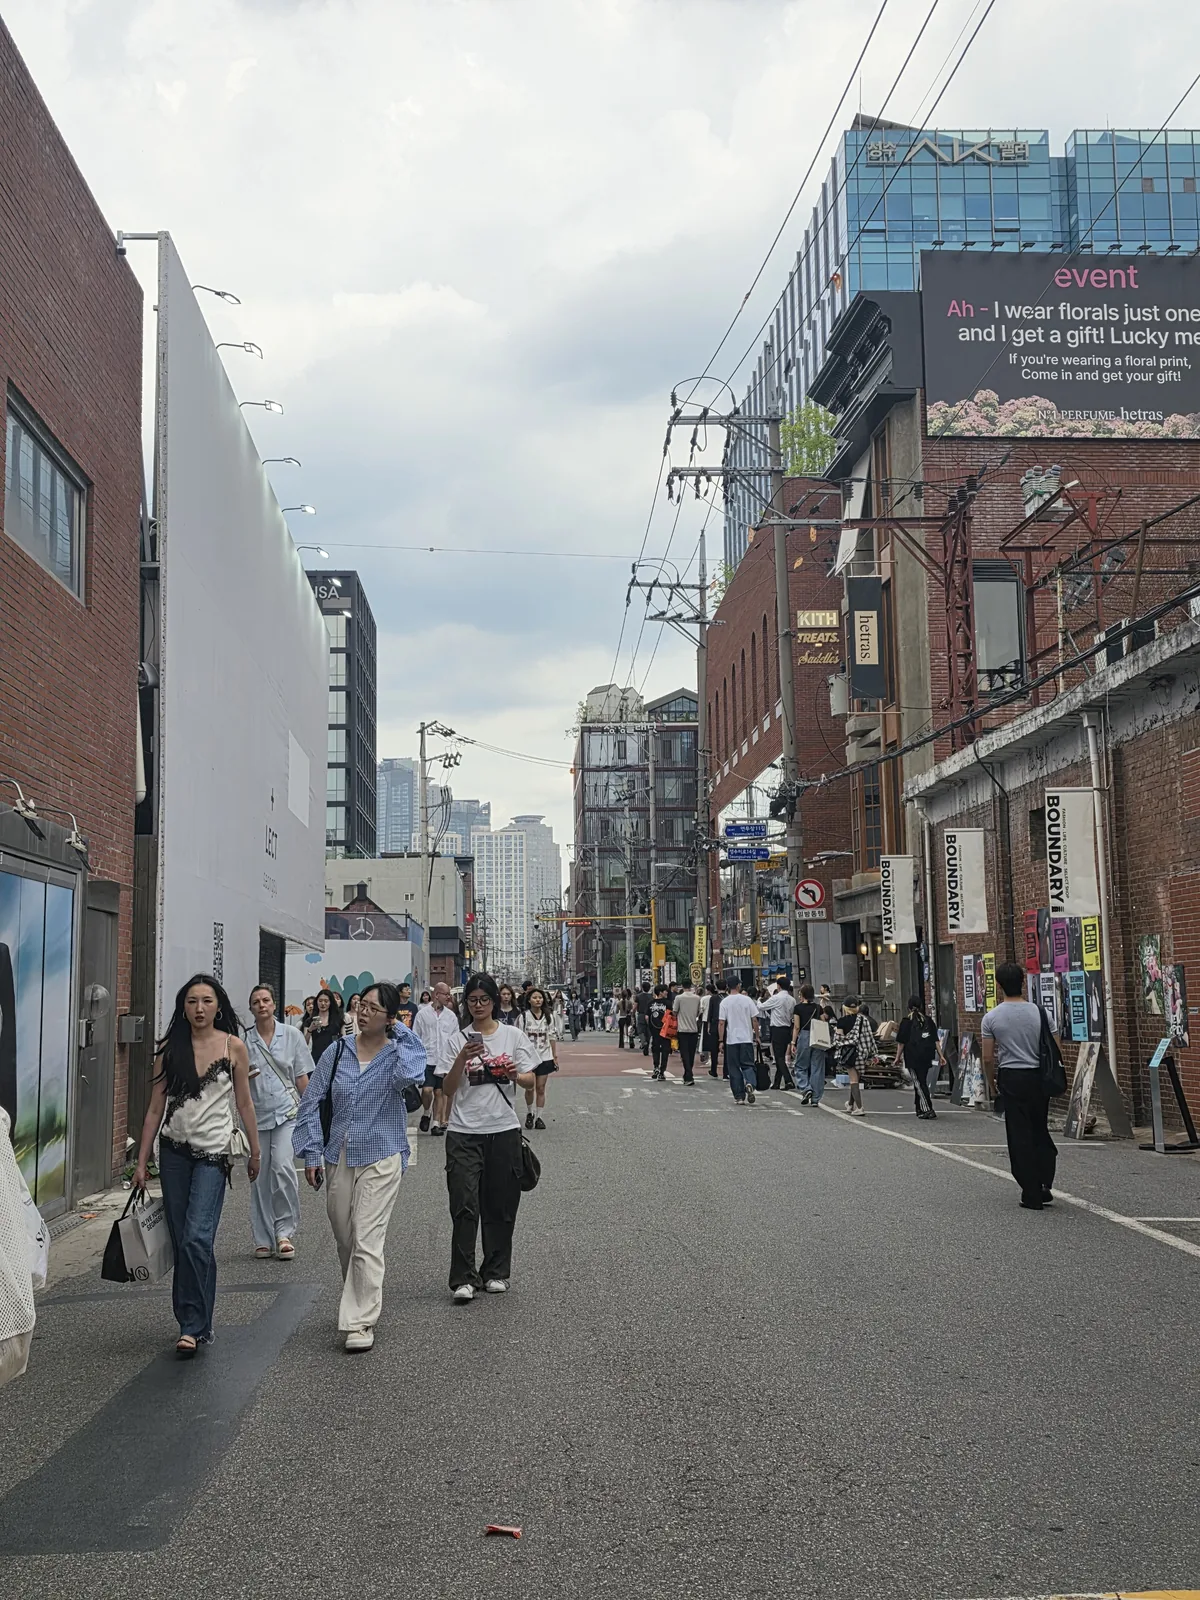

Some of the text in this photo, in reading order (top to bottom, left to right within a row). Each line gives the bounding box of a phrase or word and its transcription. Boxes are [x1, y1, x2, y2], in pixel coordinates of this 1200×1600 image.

[1054, 265, 1138, 288] event
[947, 300, 974, 318] Ah
[994, 302, 1000, 318] I
[1004, 304, 1054, 320] wear
[1059, 302, 1120, 321] florals
[1124, 304, 1160, 324] just
[958, 324, 996, 342] and
[1002, 325, 1006, 342] I
[1012, 327, 1044, 346] get
[1050, 330, 1061, 344] a
[1066, 326, 1104, 348] gift!
[1110, 328, 1169, 348] Lucky
[1009, 353, 1192, 369] If you're wearing a floral print,
[1022, 369, 1182, 384] Come in and get your gift!
[1060, 410, 1116, 420] PERFUME
[800, 612, 836, 626] KITH
[798, 632, 840, 643] TREATS.
[1047, 796, 1064, 904] BOUNDARY
[946, 834, 960, 922] BOUNDARY
[881, 860, 893, 934] BOUNDARY
